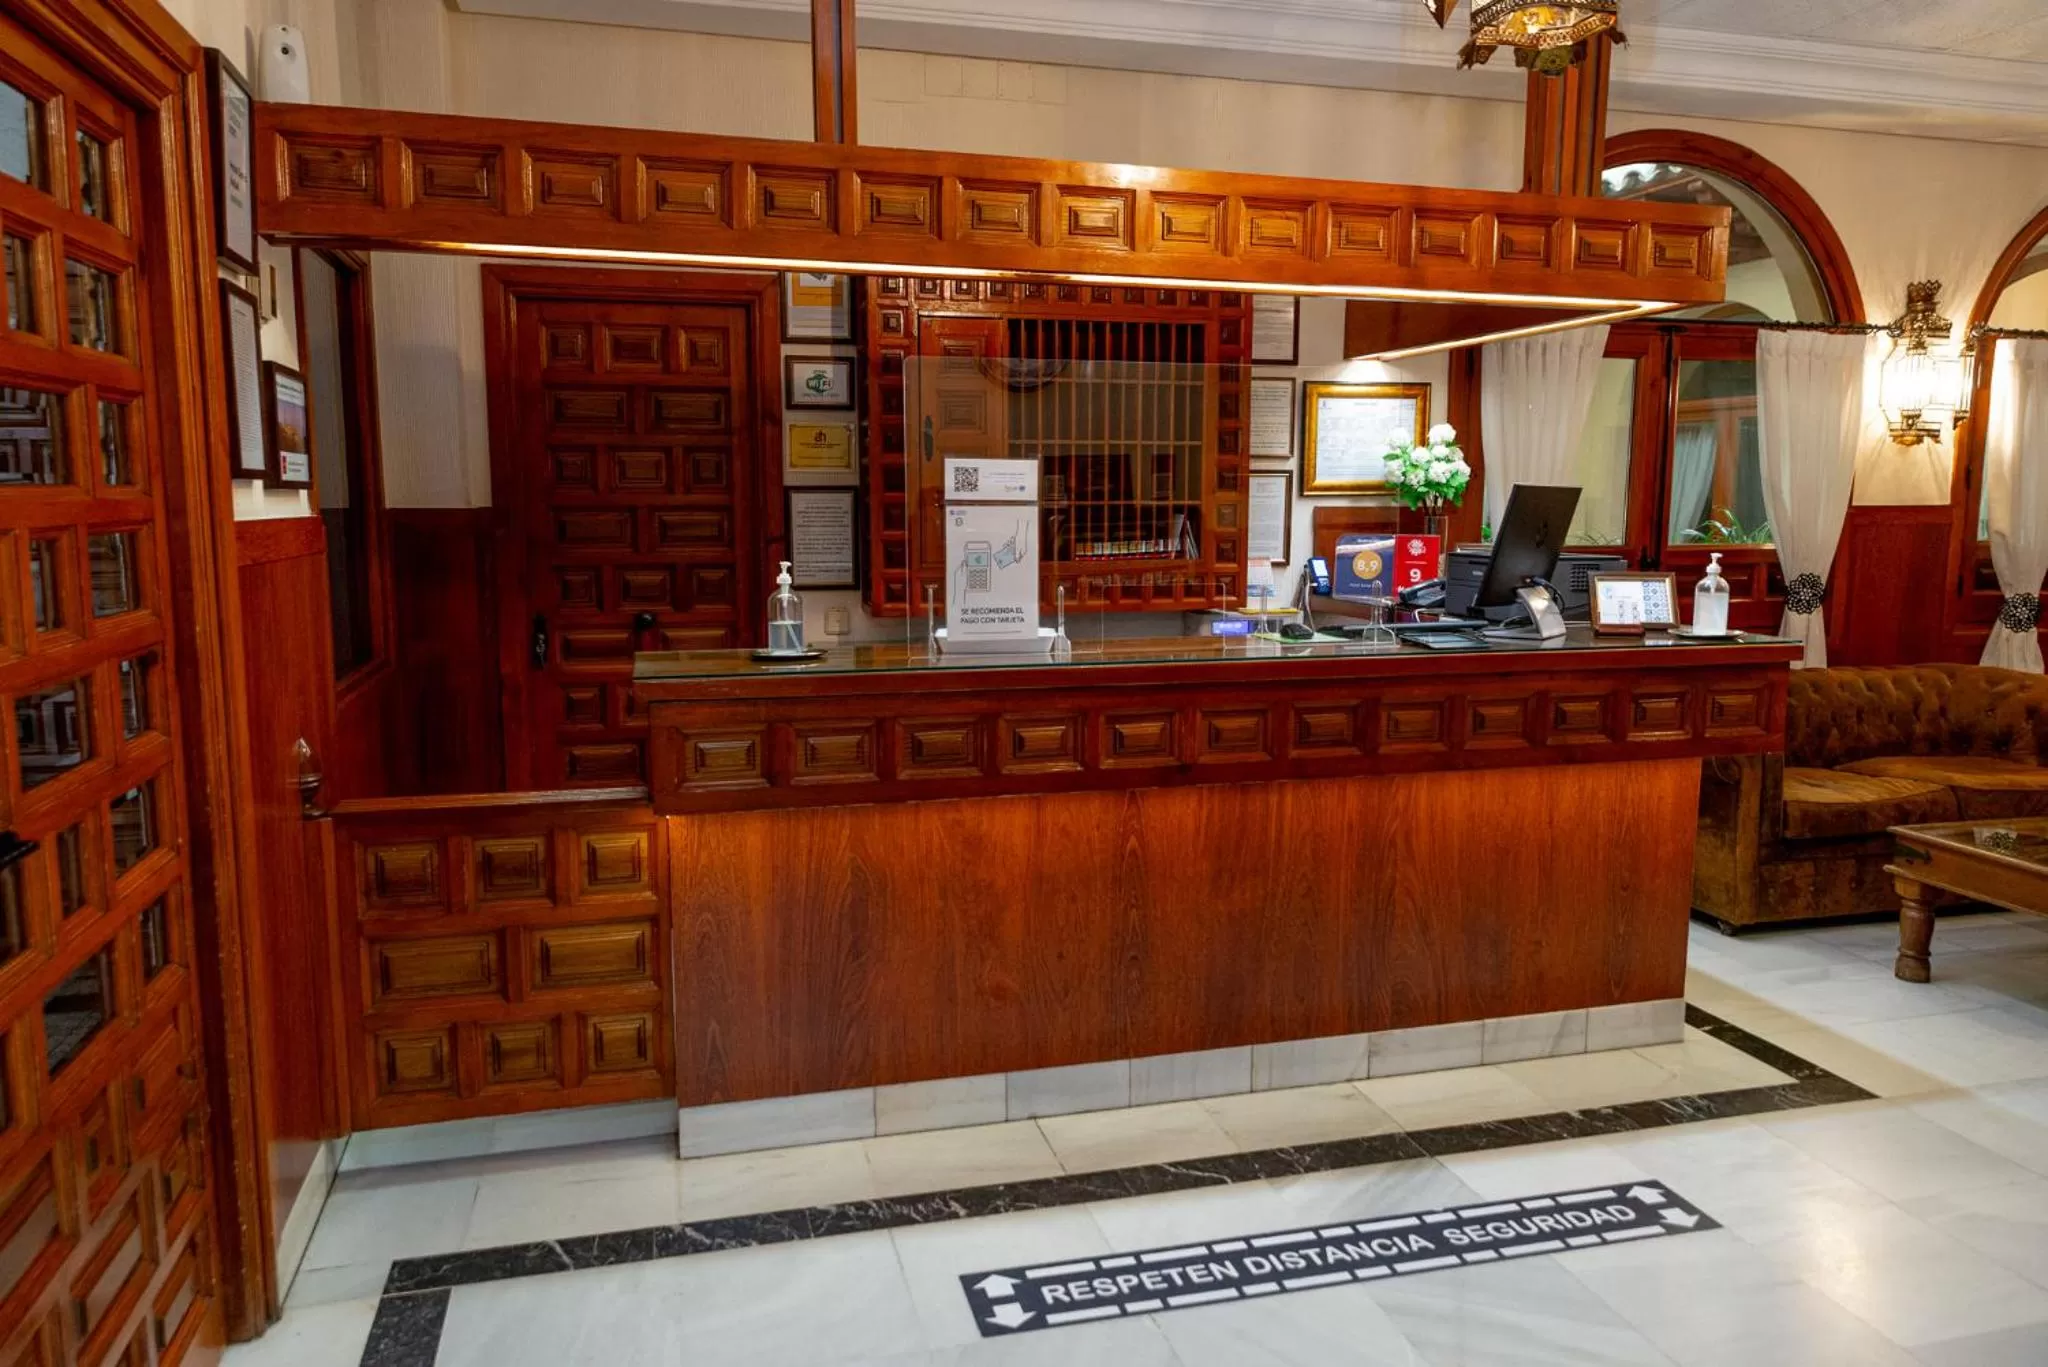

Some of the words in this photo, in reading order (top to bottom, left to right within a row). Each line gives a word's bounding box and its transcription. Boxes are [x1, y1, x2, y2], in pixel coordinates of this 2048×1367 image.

[970, 607, 1015, 615] RECOMIENDA
[997, 616, 1025, 624] TARJETA
[1039, 1259, 1240, 1306] RESPETEN
[1241, 1233, 1436, 1278] DISTANCIA
[1442, 1204, 1637, 1247] SEGURIDAD
